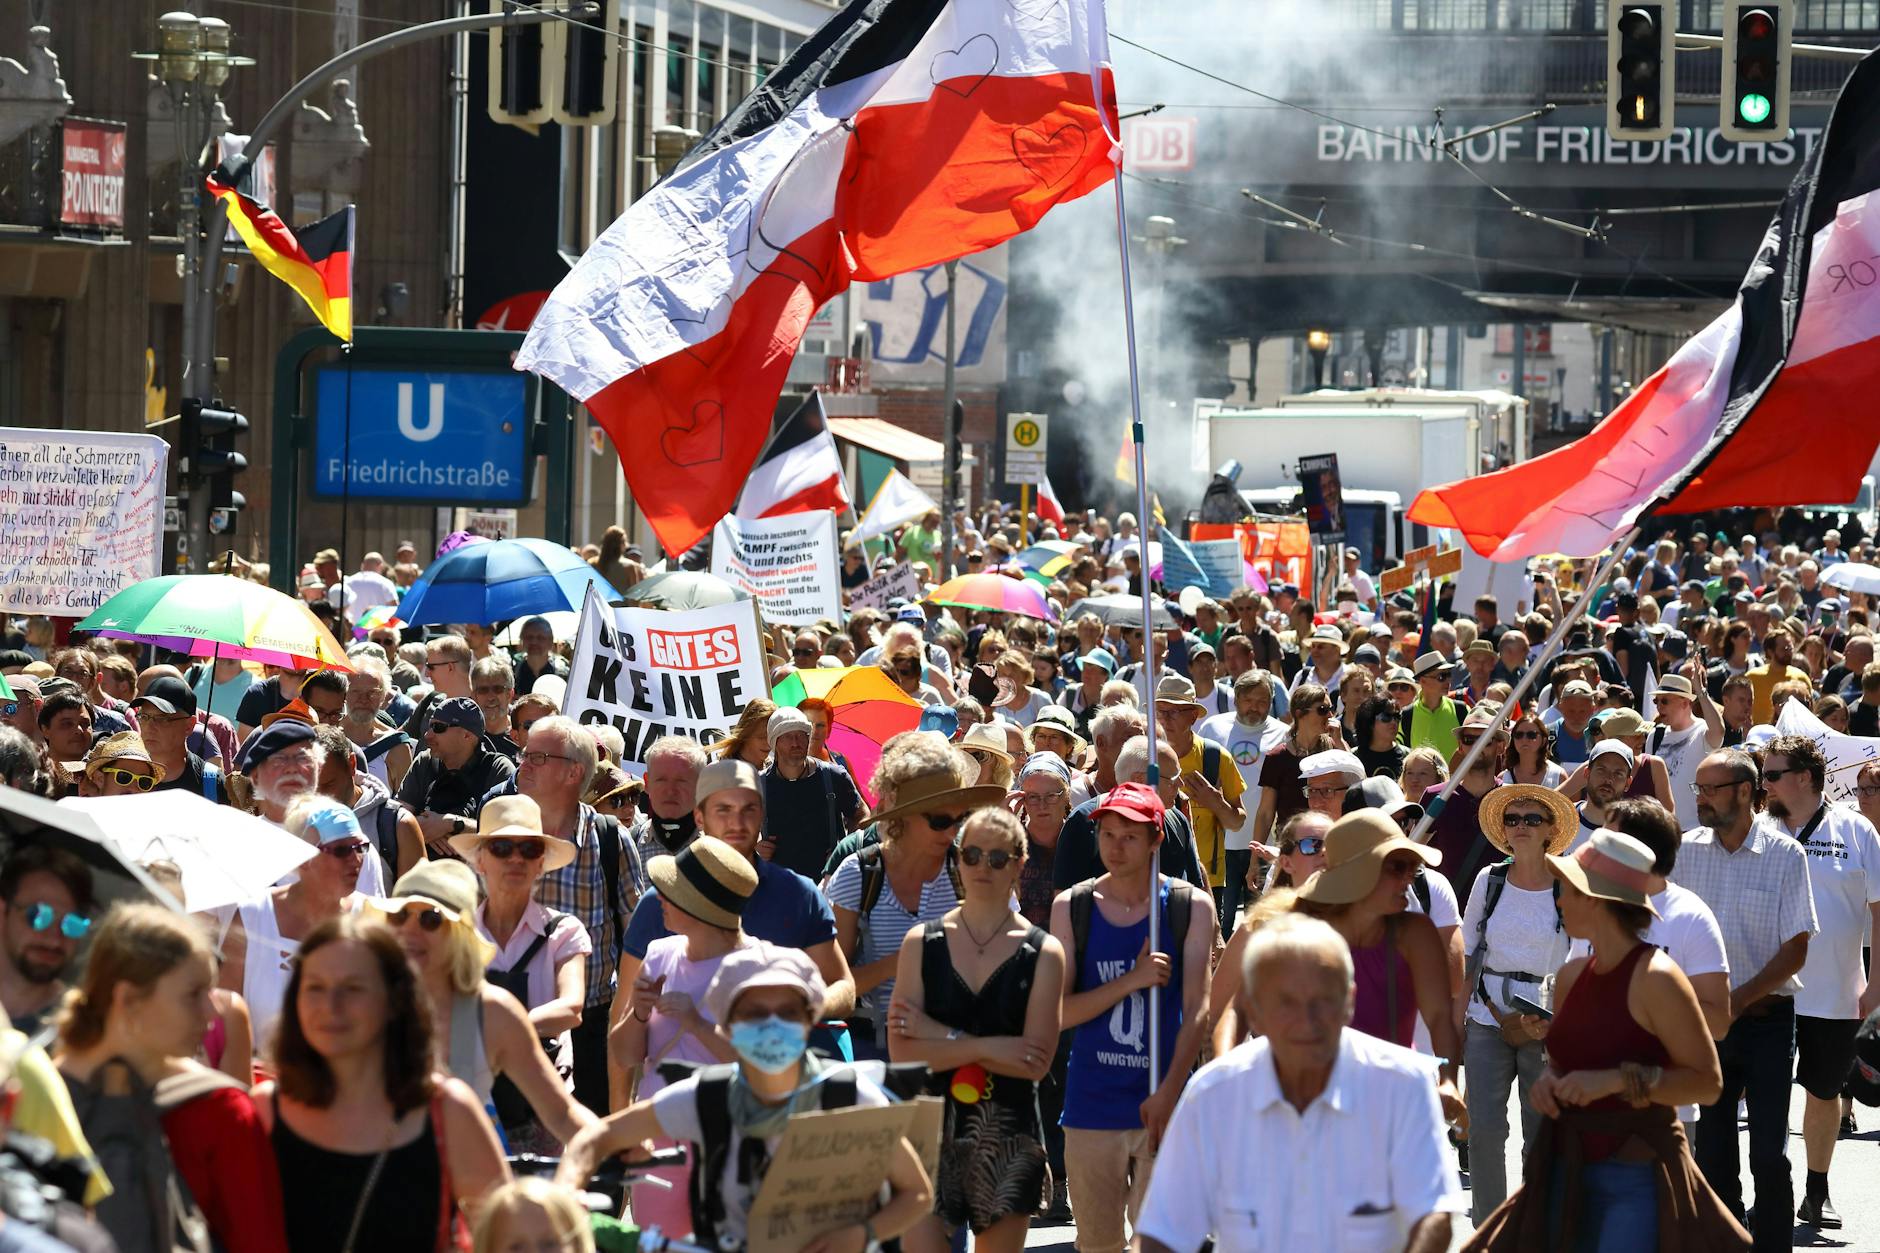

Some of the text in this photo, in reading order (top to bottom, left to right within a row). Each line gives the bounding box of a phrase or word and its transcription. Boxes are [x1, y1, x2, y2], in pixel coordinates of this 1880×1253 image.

[1136, 127, 1184, 161] DB
[1317, 125, 1521, 164] BAHNHOF
[64, 171, 124, 216] POINTIERT
[397, 382, 445, 442] U
[34, 445, 49, 463] all
[55, 445, 72, 463] die
[75, 446, 141, 465] Schmerzen
[36, 466, 99, 486] verzweifelte
[102, 468, 135, 485] Herzen
[328, 459, 510, 487] Friedrichstraße
[22, 490, 40, 505] nur
[42, 488, 76, 507] strickt
[78, 489, 124, 510] gefasst
[58, 516, 80, 528] zum
[85, 511, 116, 529] Knast
[31, 530, 49, 546] noch
[740, 541, 819, 554] AMPF zwischen
[36, 549, 78, 567] schnöden
[754, 556, 775, 567] und
[777, 553, 813, 566] Rechts
[12, 569, 46, 585] Denken
[80, 569, 94, 587] sie
[96, 569, 125, 590] nicht
[801, 575, 814, 583] der
[9, 586, 32, 605] alle
[788, 585, 804, 595] und
[807, 585, 821, 593] hat
[253, 635, 321, 654] GEMEINSAM
[649, 629, 739, 668] GATES
[586, 654, 746, 720] KEINE
[1804, 839, 1848, 849] Schweine-
[1834, 850, 1848, 860] 2.0
[1108, 991, 1145, 1053] Q
